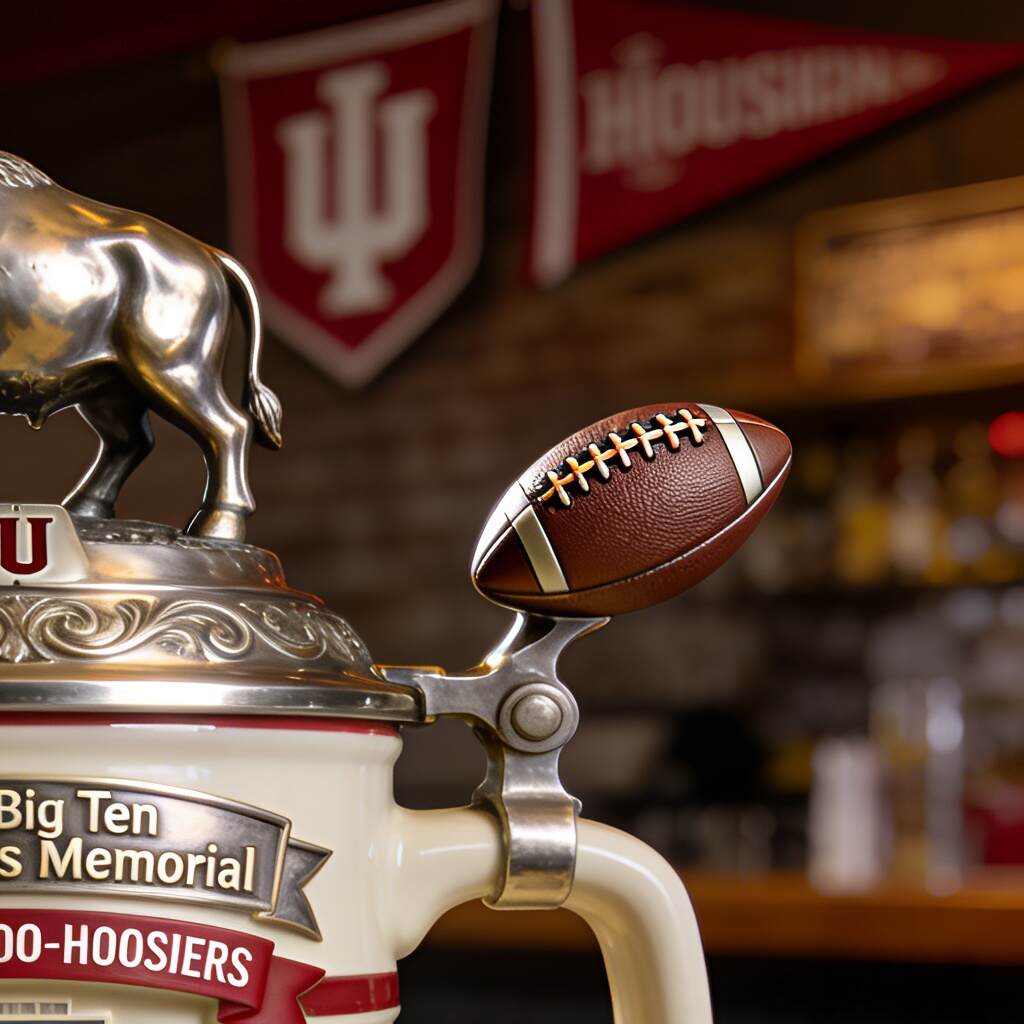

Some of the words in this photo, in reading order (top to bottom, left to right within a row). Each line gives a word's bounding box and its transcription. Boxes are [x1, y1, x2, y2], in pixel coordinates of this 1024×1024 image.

[278, 64, 438, 315] IU
[76, 789, 159, 836] Ten
[38, 838, 257, 892] Memorial
